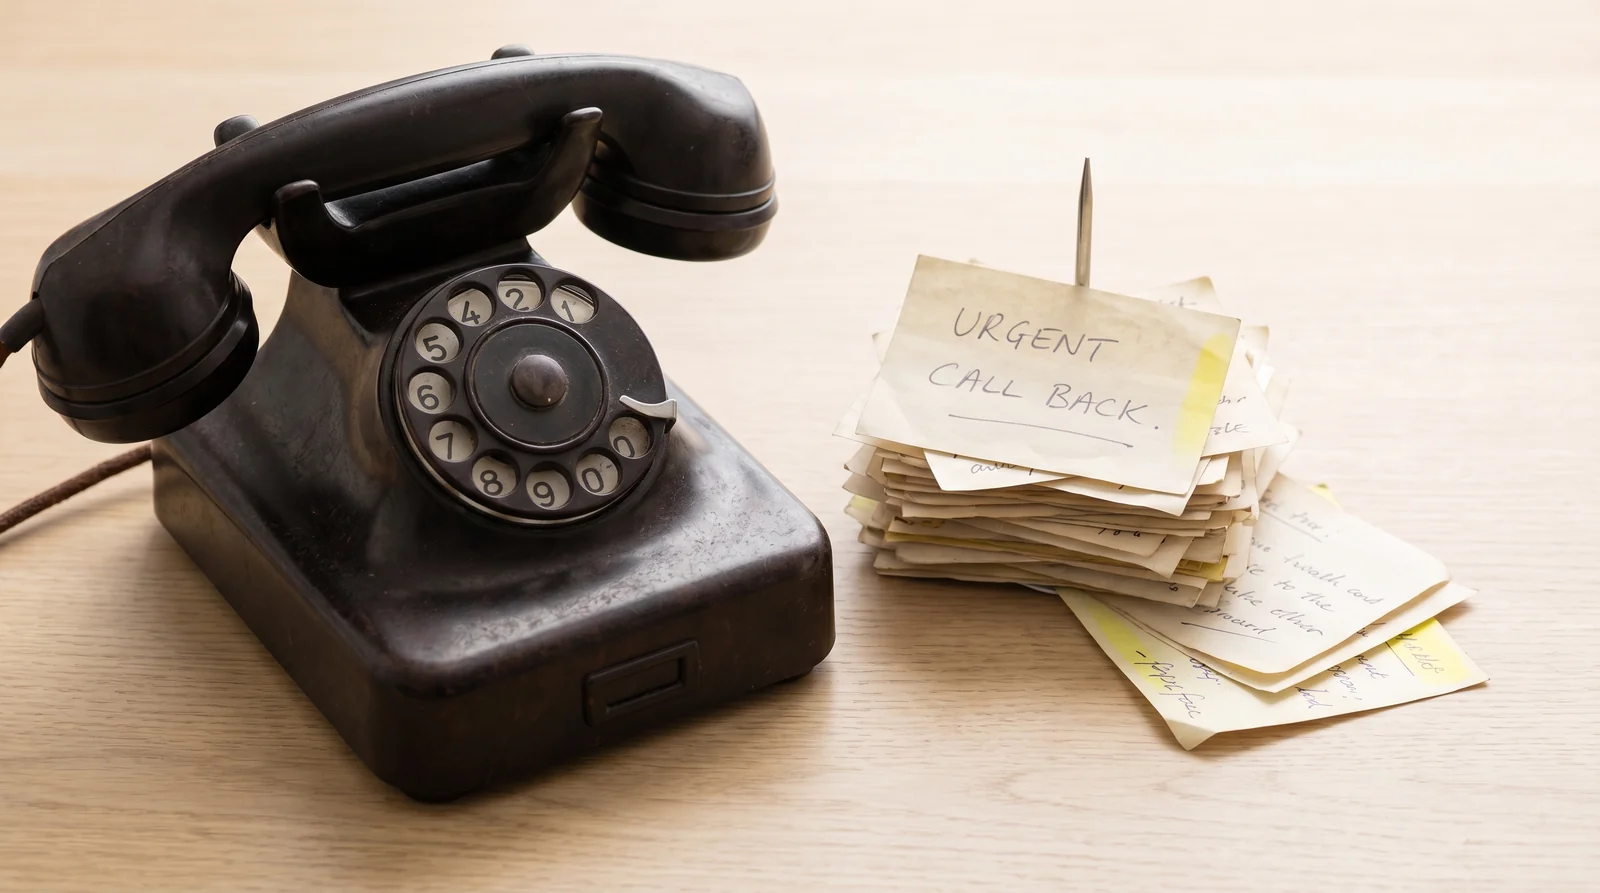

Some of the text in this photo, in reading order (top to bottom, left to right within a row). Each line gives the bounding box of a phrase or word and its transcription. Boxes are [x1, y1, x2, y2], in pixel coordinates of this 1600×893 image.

[461, 301, 482, 324] 4
[505, 288, 529, 311] 2
[561, 300, 574, 322] 1
[423, 335, 447, 361] 5
[954, 307, 1119, 363] URGENT
[417, 385, 440, 410] 6
[928, 363, 1160, 430] CALL BACK.
[435, 432, 453, 460] 7
[480, 470, 504, 496] 8
[581, 467, 605, 493] 0
[533, 481, 556, 507] 9
[1301, 590, 1335, 611] the
